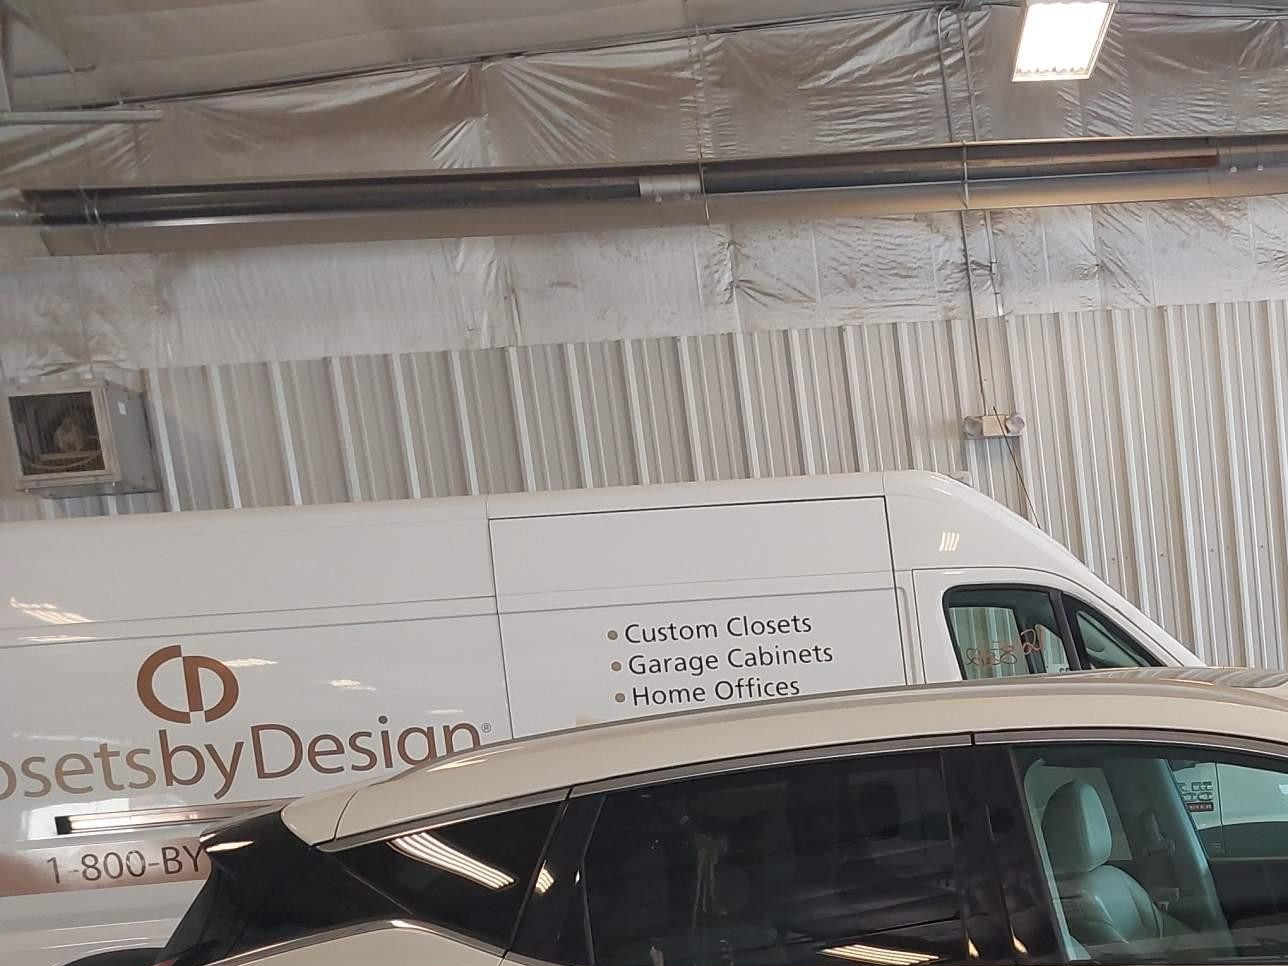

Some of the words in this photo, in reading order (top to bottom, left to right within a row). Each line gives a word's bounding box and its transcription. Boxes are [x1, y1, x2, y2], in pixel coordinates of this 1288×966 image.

[625, 623, 718, 643] Custom
[727, 616, 812, 637] Closets
[628, 655, 719, 676] Garage
[728, 645, 833, 668] Cabinets
[632, 685, 706, 706] Home
[715, 678, 800, 700] Offices
